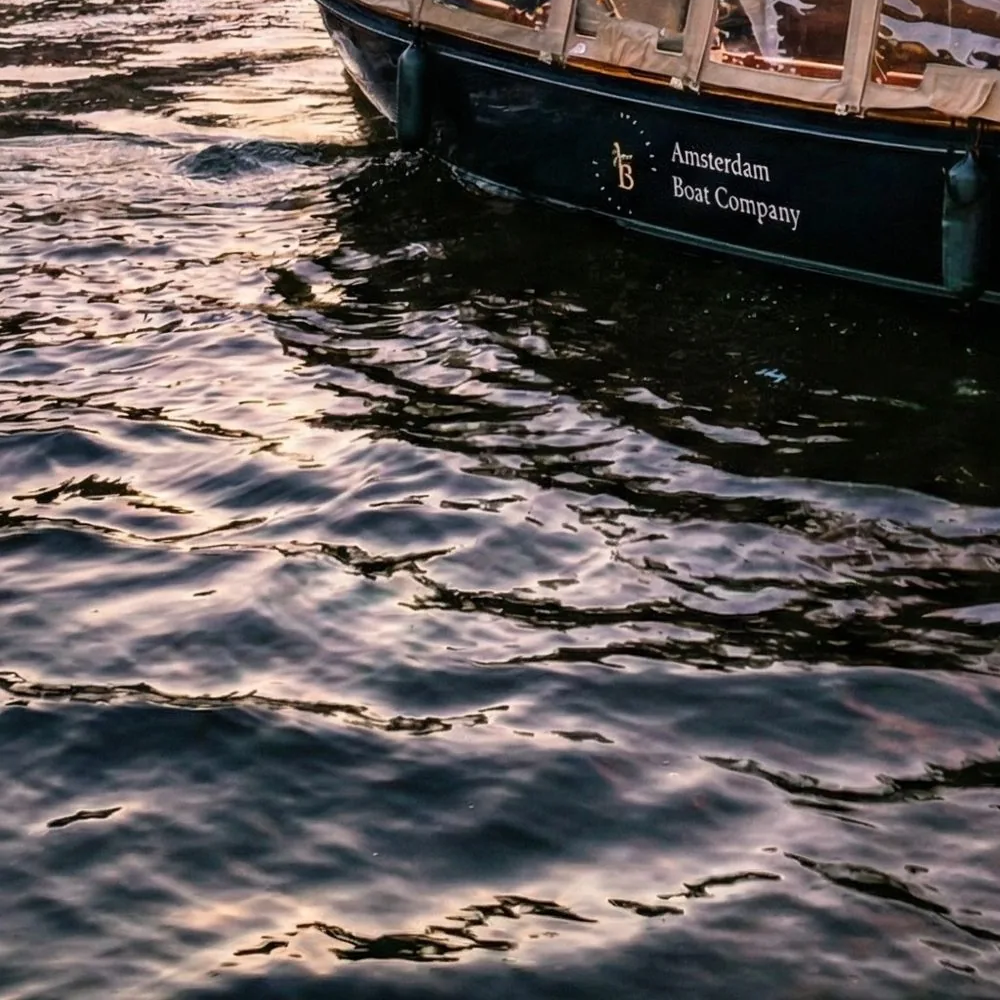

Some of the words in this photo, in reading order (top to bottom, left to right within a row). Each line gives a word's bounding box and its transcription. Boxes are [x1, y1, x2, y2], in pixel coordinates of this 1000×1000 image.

[671, 141, 771, 182] Amsterdam
[672, 175, 711, 205] Boat
[714, 186, 801, 231] Company
